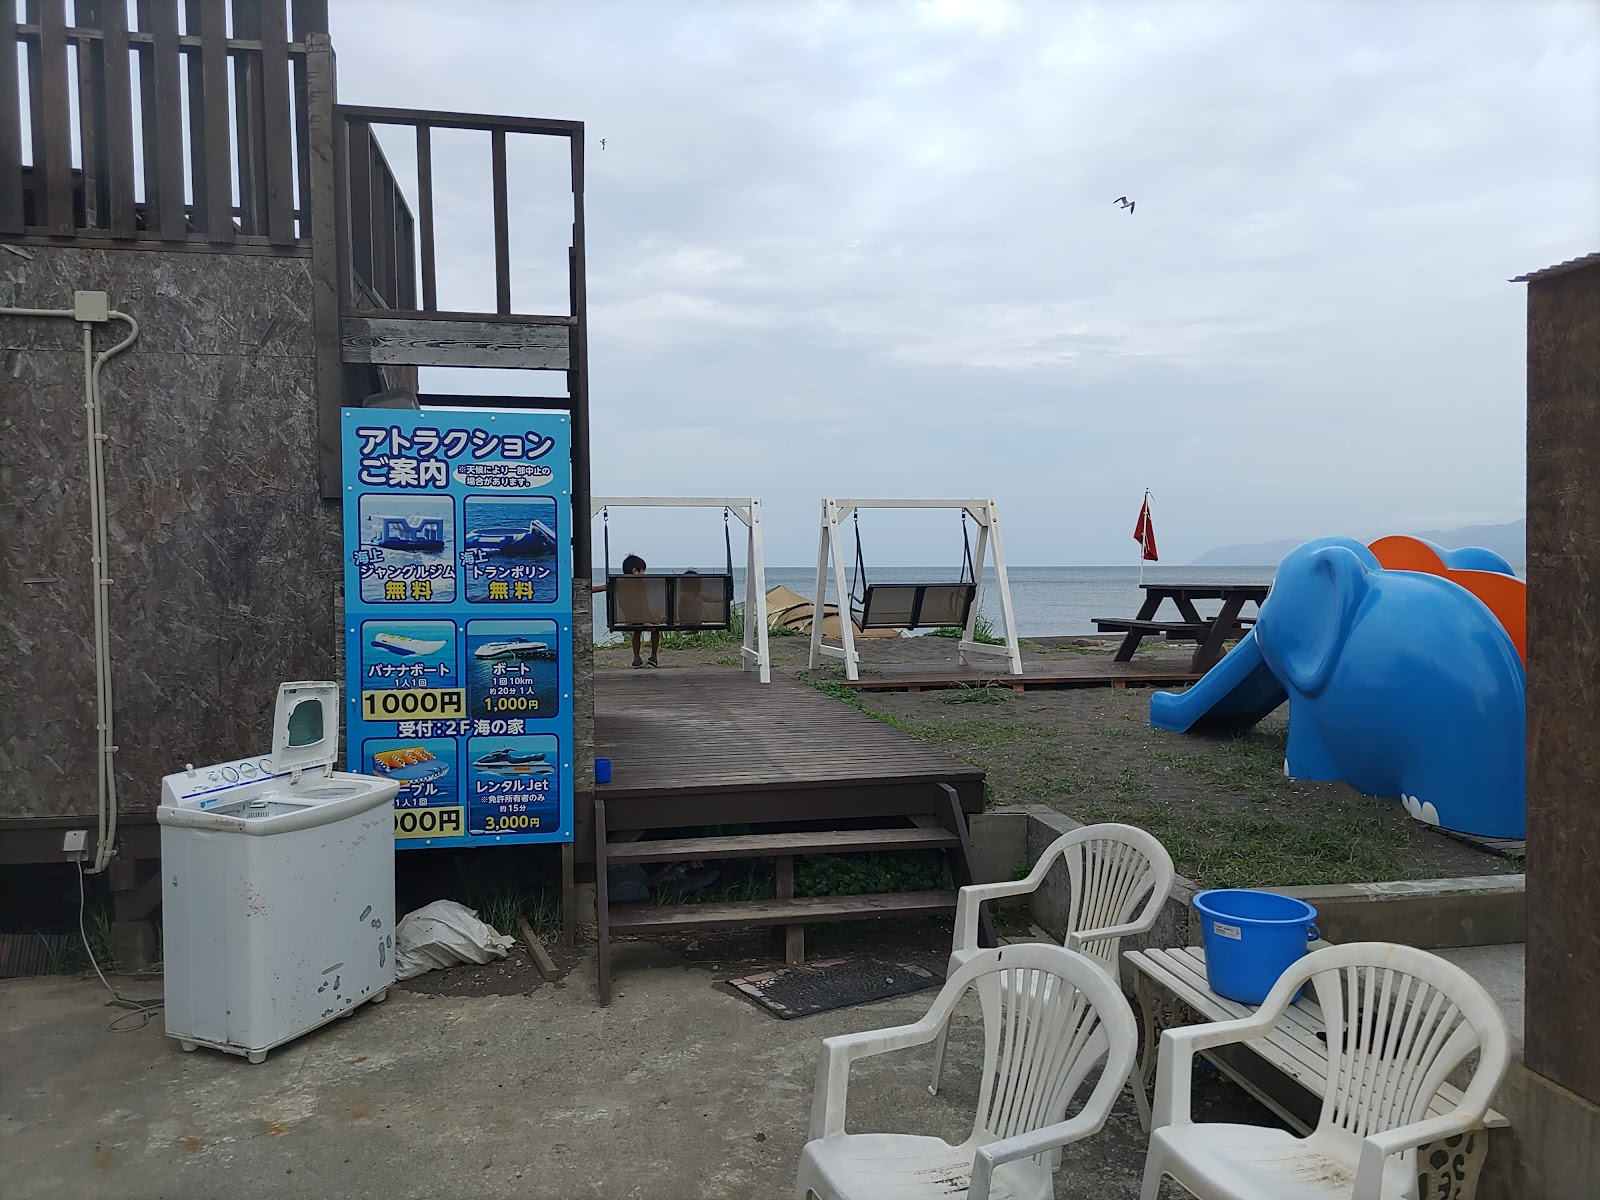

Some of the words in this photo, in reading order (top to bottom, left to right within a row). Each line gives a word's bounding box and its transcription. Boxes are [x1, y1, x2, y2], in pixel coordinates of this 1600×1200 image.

[357, 427, 553, 459] アトラクション
[360, 457, 448, 488] ご案内
[466, 476, 531, 487] 場合があります。
[354, 549, 384, 565] 海上
[460, 549, 489, 565] 海上
[361, 565, 456, 579] ジャングルジム
[472, 565, 550, 579] トランポリン
[385, 580, 433, 600] 無料
[489, 580, 534, 600] 無料
[368, 663, 450, 677] バナナボート
[493, 662, 530, 675] ボート
[395, 678, 427, 687] 1人1回
[364, 691, 462, 715] 1000円
[484, 697, 539, 712] 1,000円
[398, 783, 438, 796] ーブル
[499, 804, 527, 813] 約15分
[394, 809, 460, 833] 00円
[485, 814, 540, 831] 3,000円
